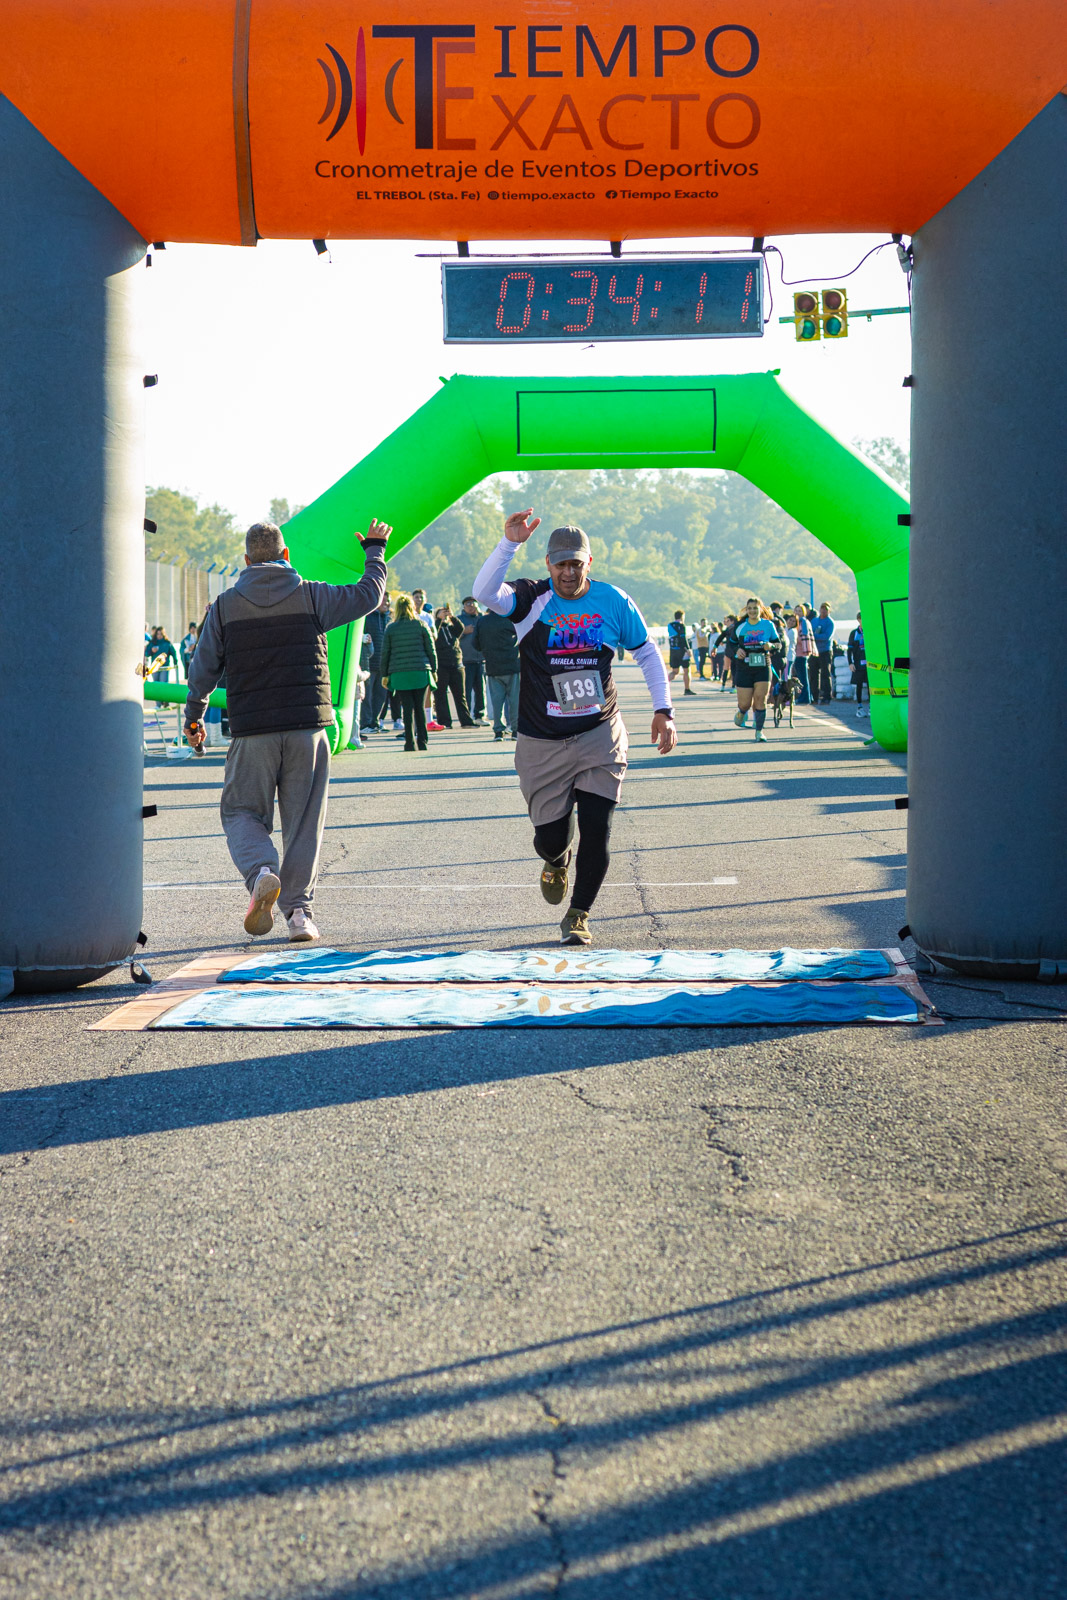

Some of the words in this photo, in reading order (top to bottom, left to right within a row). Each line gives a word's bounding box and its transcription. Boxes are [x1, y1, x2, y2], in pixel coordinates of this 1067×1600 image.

[315, 160, 478, 182] Cronometraje
[484, 159, 514, 178] de
[522, 160, 616, 178] Eventos
[625, 159, 759, 181] Deportivos
[356, 191, 372, 200] EL
[374, 191, 425, 200] TREBOL
[428, 190, 458, 201] (Sta.
[461, 190, 480, 201] Fe)
[502, 190, 596, 202] tiempo.exacto
[620, 189, 671, 201] Tiempo
[674, 189, 719, 200] Exacto
[495, 270, 753, 334] 0:34:11
[550, 658, 575, 666] RAFAELA,
[754, 655, 762, 664] 10
[563, 678, 596, 701] 139
